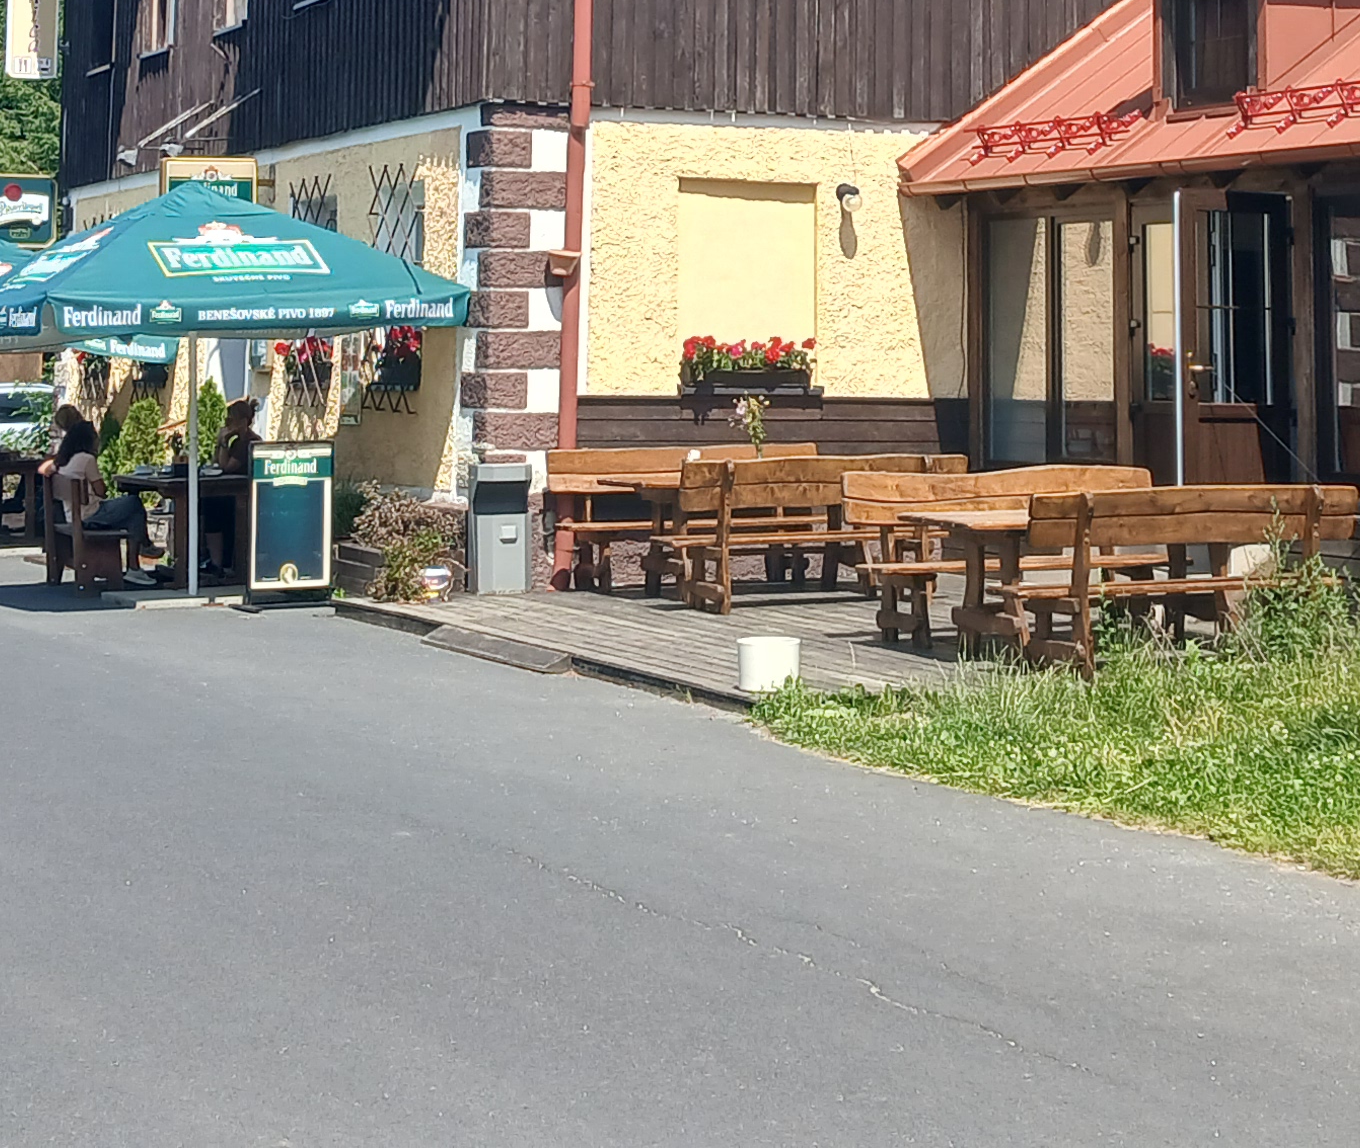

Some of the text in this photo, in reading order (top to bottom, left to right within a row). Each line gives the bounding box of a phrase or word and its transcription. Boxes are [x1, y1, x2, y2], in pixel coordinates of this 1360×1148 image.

[161, 245, 314, 269] Ferdinand
[63, 304, 142, 327] Ferdinand
[197, 307, 335, 321] BENEŠOVSKÉ PIVO 1897
[385, 298, 454, 318] Ferdinand
[110, 339, 166, 358] Ferdinand
[264, 458, 318, 475] Ferdinand
